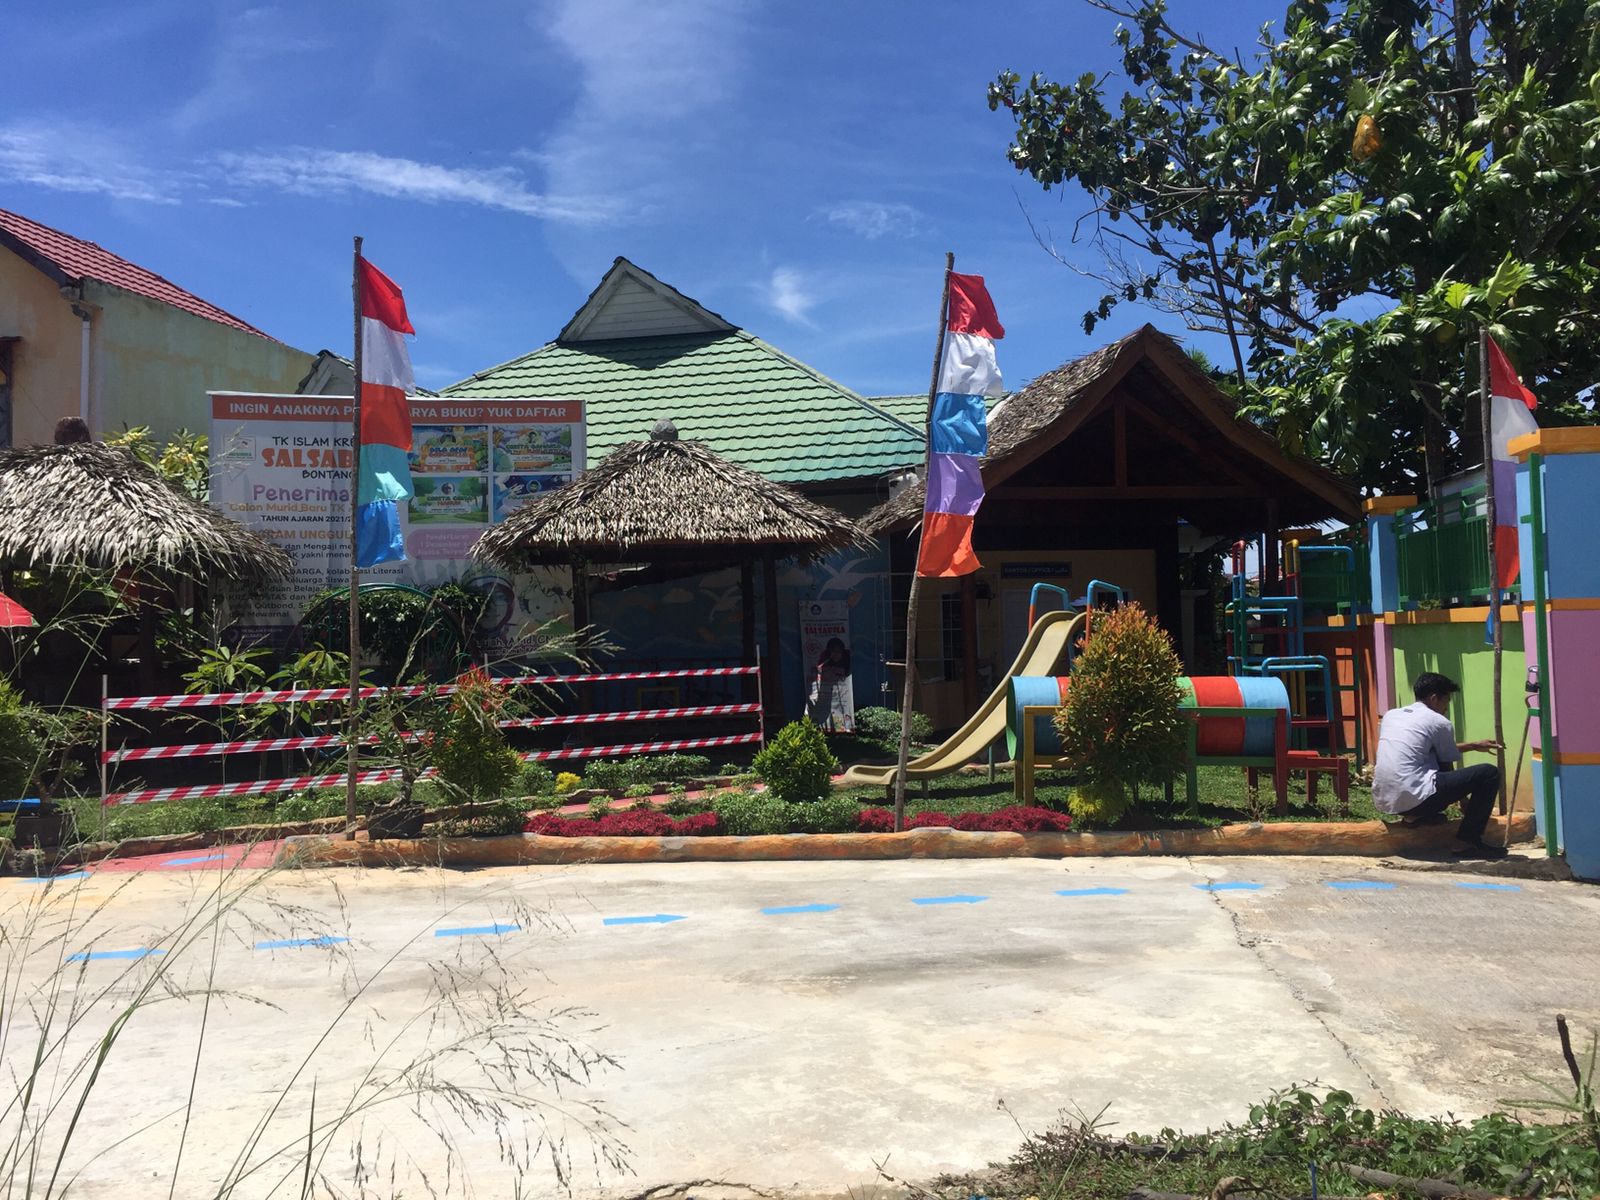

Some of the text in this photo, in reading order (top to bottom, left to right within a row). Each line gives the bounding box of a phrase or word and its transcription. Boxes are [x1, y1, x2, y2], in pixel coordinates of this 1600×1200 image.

[229, 402, 269, 414] INGIN
[273, 404, 340, 415] ANAKNYA
[441, 407, 483, 418] BUKU?
[487, 407, 512, 418] YUK
[516, 407, 566, 418] DAFTAR
[272, 436, 289, 446] TK
[293, 437, 329, 447] ISLAM
[261, 447, 352, 469] SALSAB
[253, 484, 352, 502] Penerima
[230, 503, 346, 512] Calon Murid Baru TK
[261, 515, 289, 523] TAHUN
[291, 515, 323, 523] AJARAN
[300, 530, 351, 541] UNGGUL
[285, 543, 301, 551] dan
[303, 543, 338, 553] Mengaji
[301, 552, 324, 561] yakni
[373, 568, 404, 576] Literasi
[325, 576, 350, 584] Siswa
